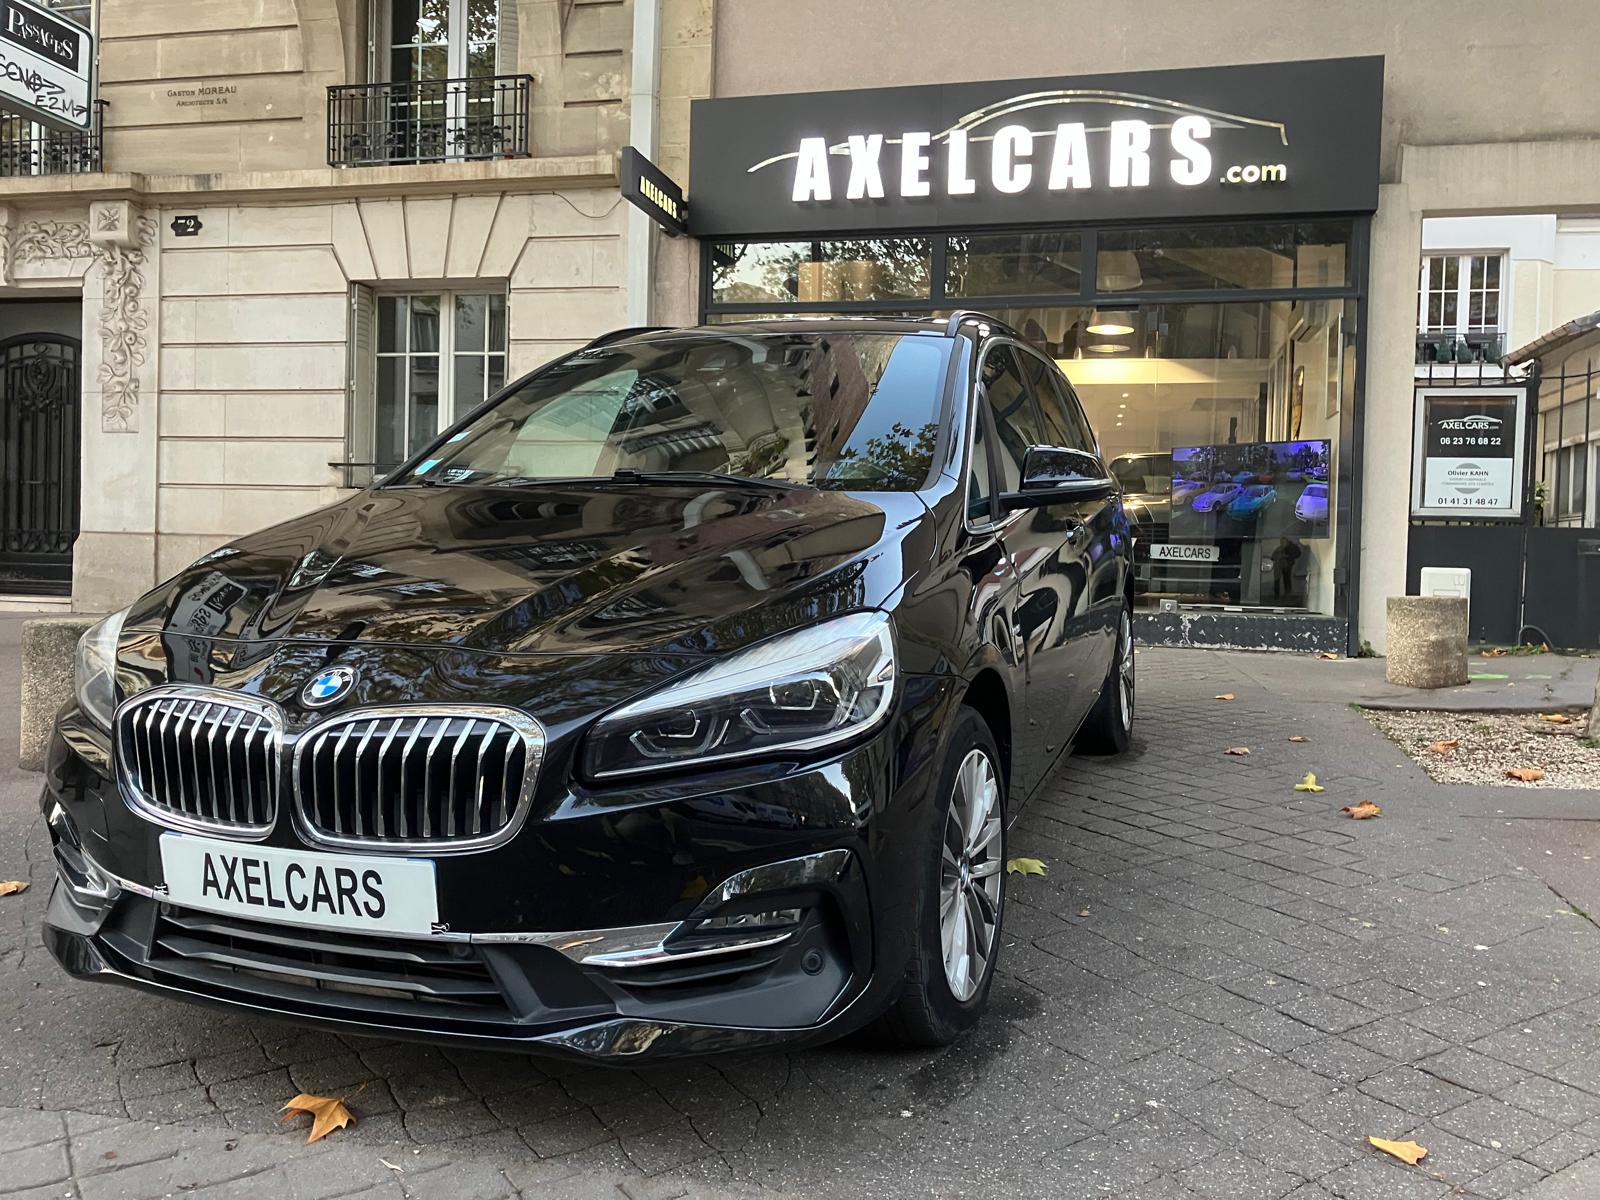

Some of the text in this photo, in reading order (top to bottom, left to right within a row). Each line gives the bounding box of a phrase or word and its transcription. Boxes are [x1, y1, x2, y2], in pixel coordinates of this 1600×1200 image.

[198, 85, 237, 96] MOREAU
[1452, 437, 1463, 445] 23
[1465, 437, 1476, 445] 76
[1490, 437, 1502, 446] 22
[1438, 497, 1447, 505] 01
[1450, 497, 1460, 505] 41
[1487, 498, 1498, 506] 47
[1159, 546, 1211, 559] AXELCARS
[202, 852, 386, 919] AXELCARS
